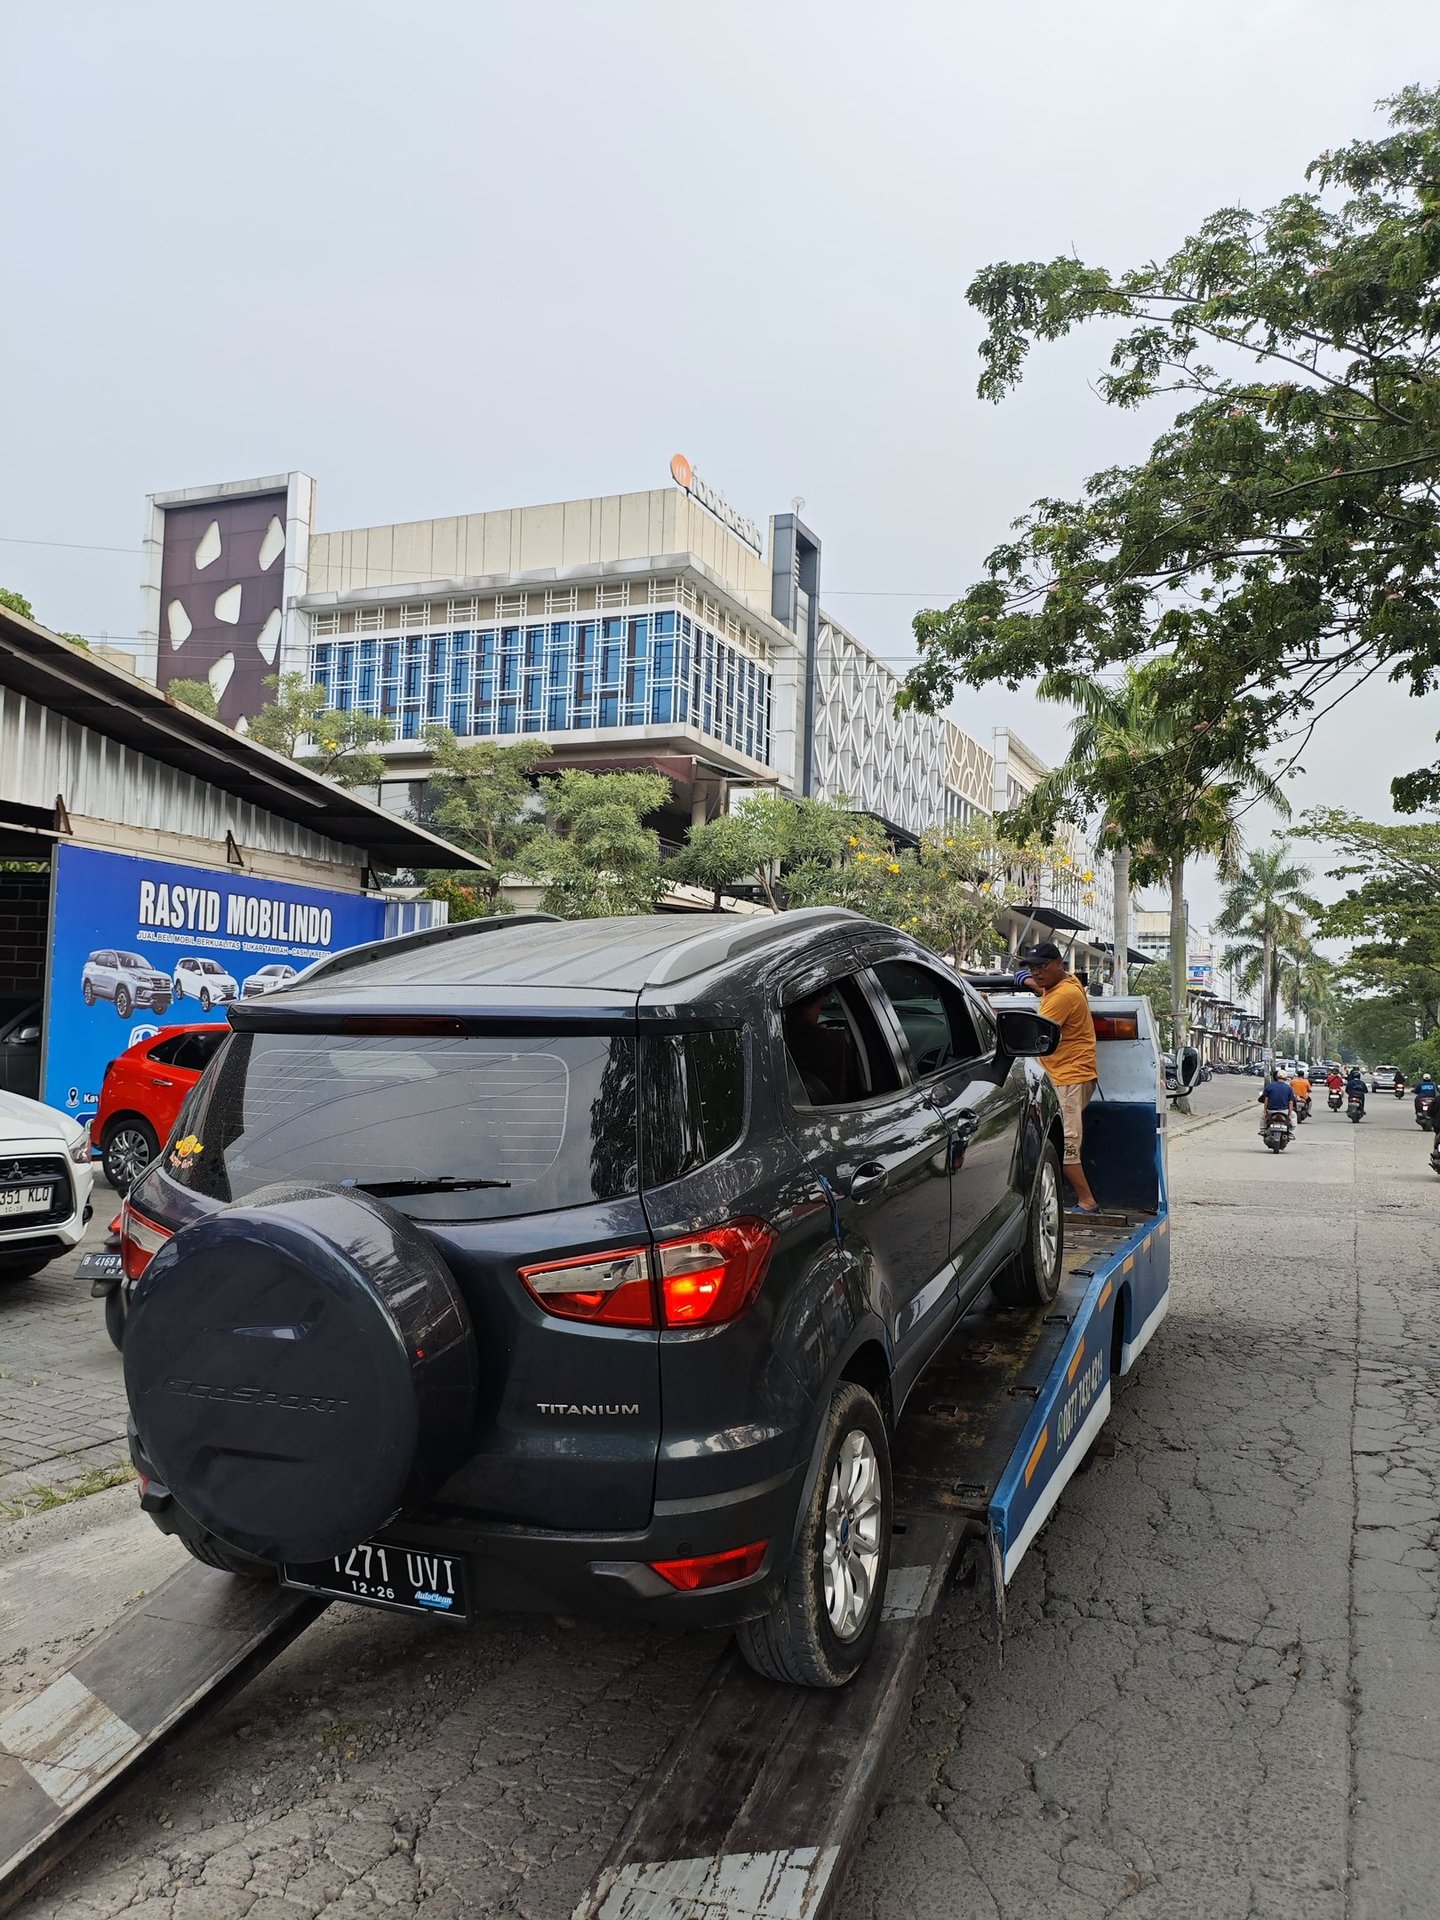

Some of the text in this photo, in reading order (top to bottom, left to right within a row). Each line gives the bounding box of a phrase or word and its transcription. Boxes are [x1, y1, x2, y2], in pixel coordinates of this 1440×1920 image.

[139, 880, 332, 946] RASYID MOBILINDO
[138, 931, 155, 941] JUAL
[157, 933, 173, 943] BELI
[174, 935, 195, 945] MOBIL
[196, 937, 240, 950] BERKUALITAS
[242, 942, 264, 953] TUKAR
[265, 944, 289, 955] TAMBAH
[83, 1256, 91, 1266] B
[95, 1256, 116, 1267] 4169
[537, 1403, 639, 1416] TITANIUM
[406, 1553, 455, 1595] UVI
[414, 1590, 453, 1606] AutoClean
